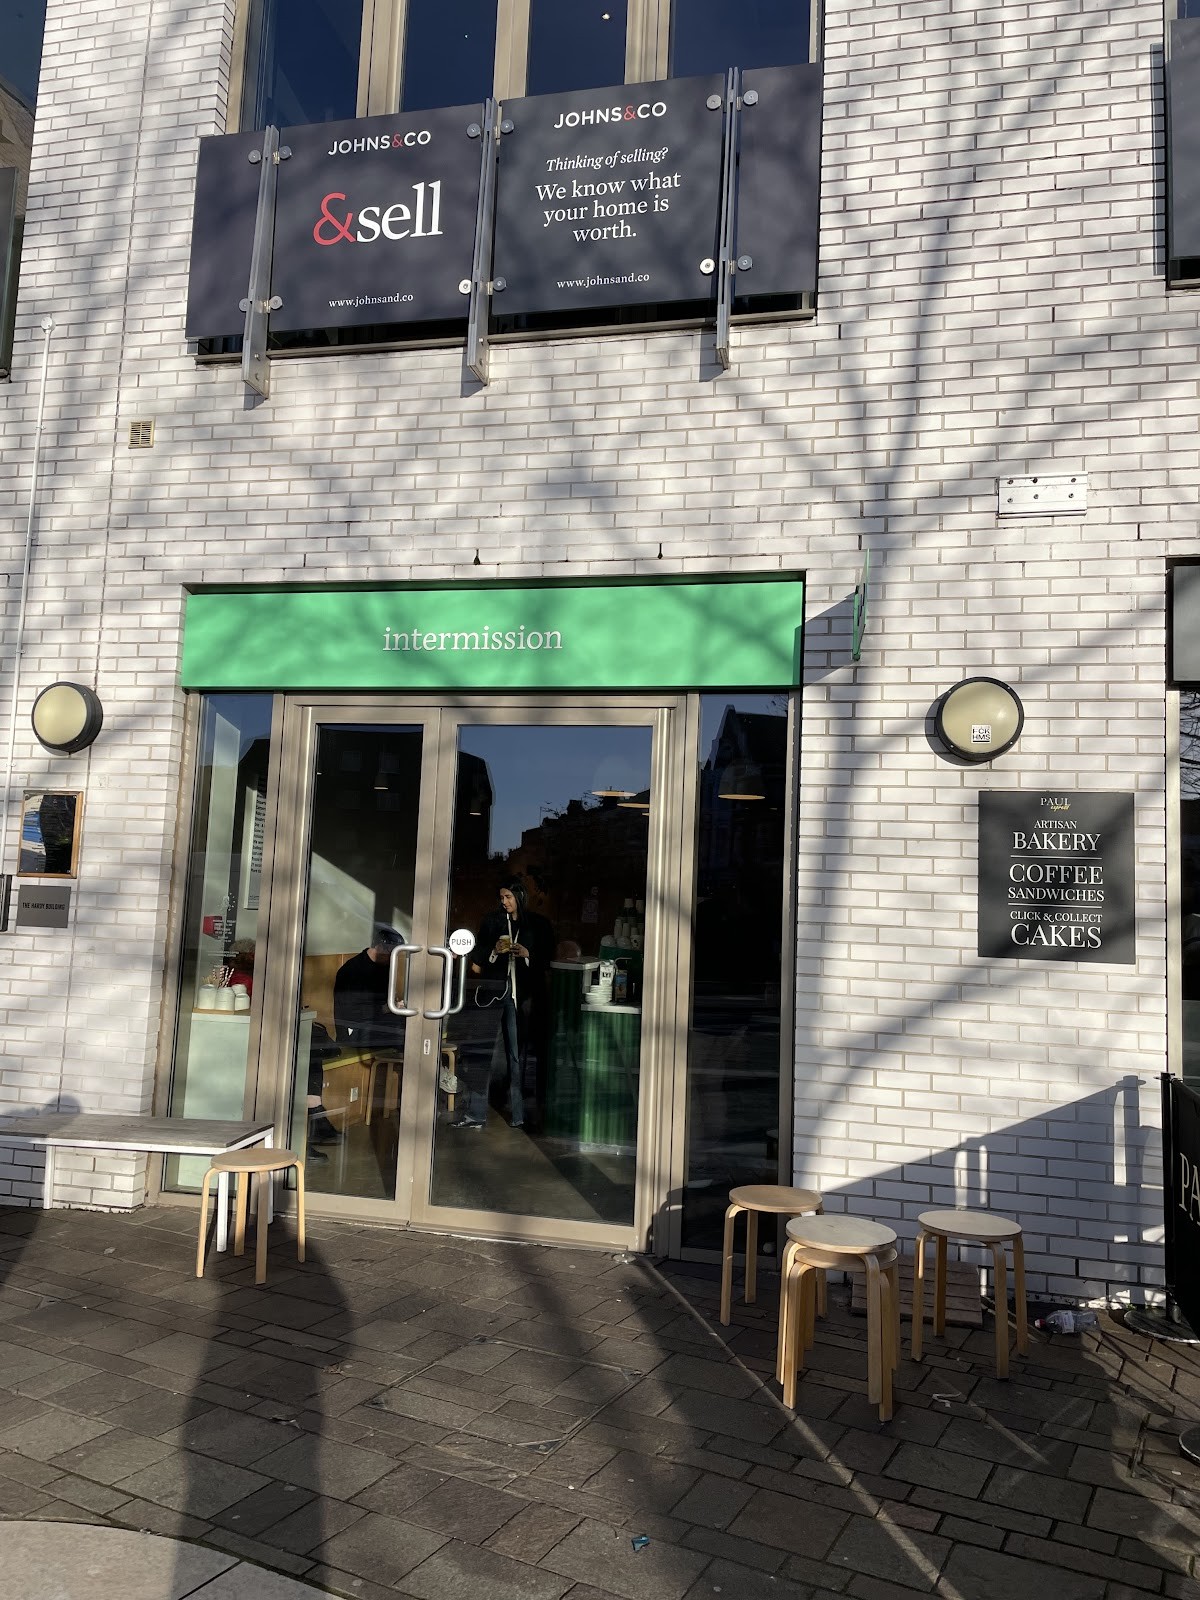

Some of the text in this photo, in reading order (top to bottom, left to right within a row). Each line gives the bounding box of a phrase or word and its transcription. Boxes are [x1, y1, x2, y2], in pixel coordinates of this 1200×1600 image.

[553, 101, 667, 129] JOHNS&CO
[328, 130, 432, 156] JOHNS&CO
[546, 147, 669, 172] Thinking of selling?
[535, 171, 681, 201] We know what
[313, 180, 443, 246] &sell
[543, 194, 670, 227] your home is
[572, 219, 637, 242] worth.
[556, 272, 650, 288] www.johnsand.co
[328, 293, 414, 308] www.johnsand.co
[382, 624, 563, 651] intermission
[1040, 797, 1071, 806] PAUL
[1033, 819, 1078, 829] ARTISAN
[1012, 831, 1101, 851] BAKERY
[1009, 863, 1104, 885] COFFEE
[1008, 886, 1105, 902] SANDWICHES
[1010, 910, 1103, 923] CLICK & COLLECT
[451, 938, 472, 946] PUSH
[1011, 923, 1102, 949] CAKES
